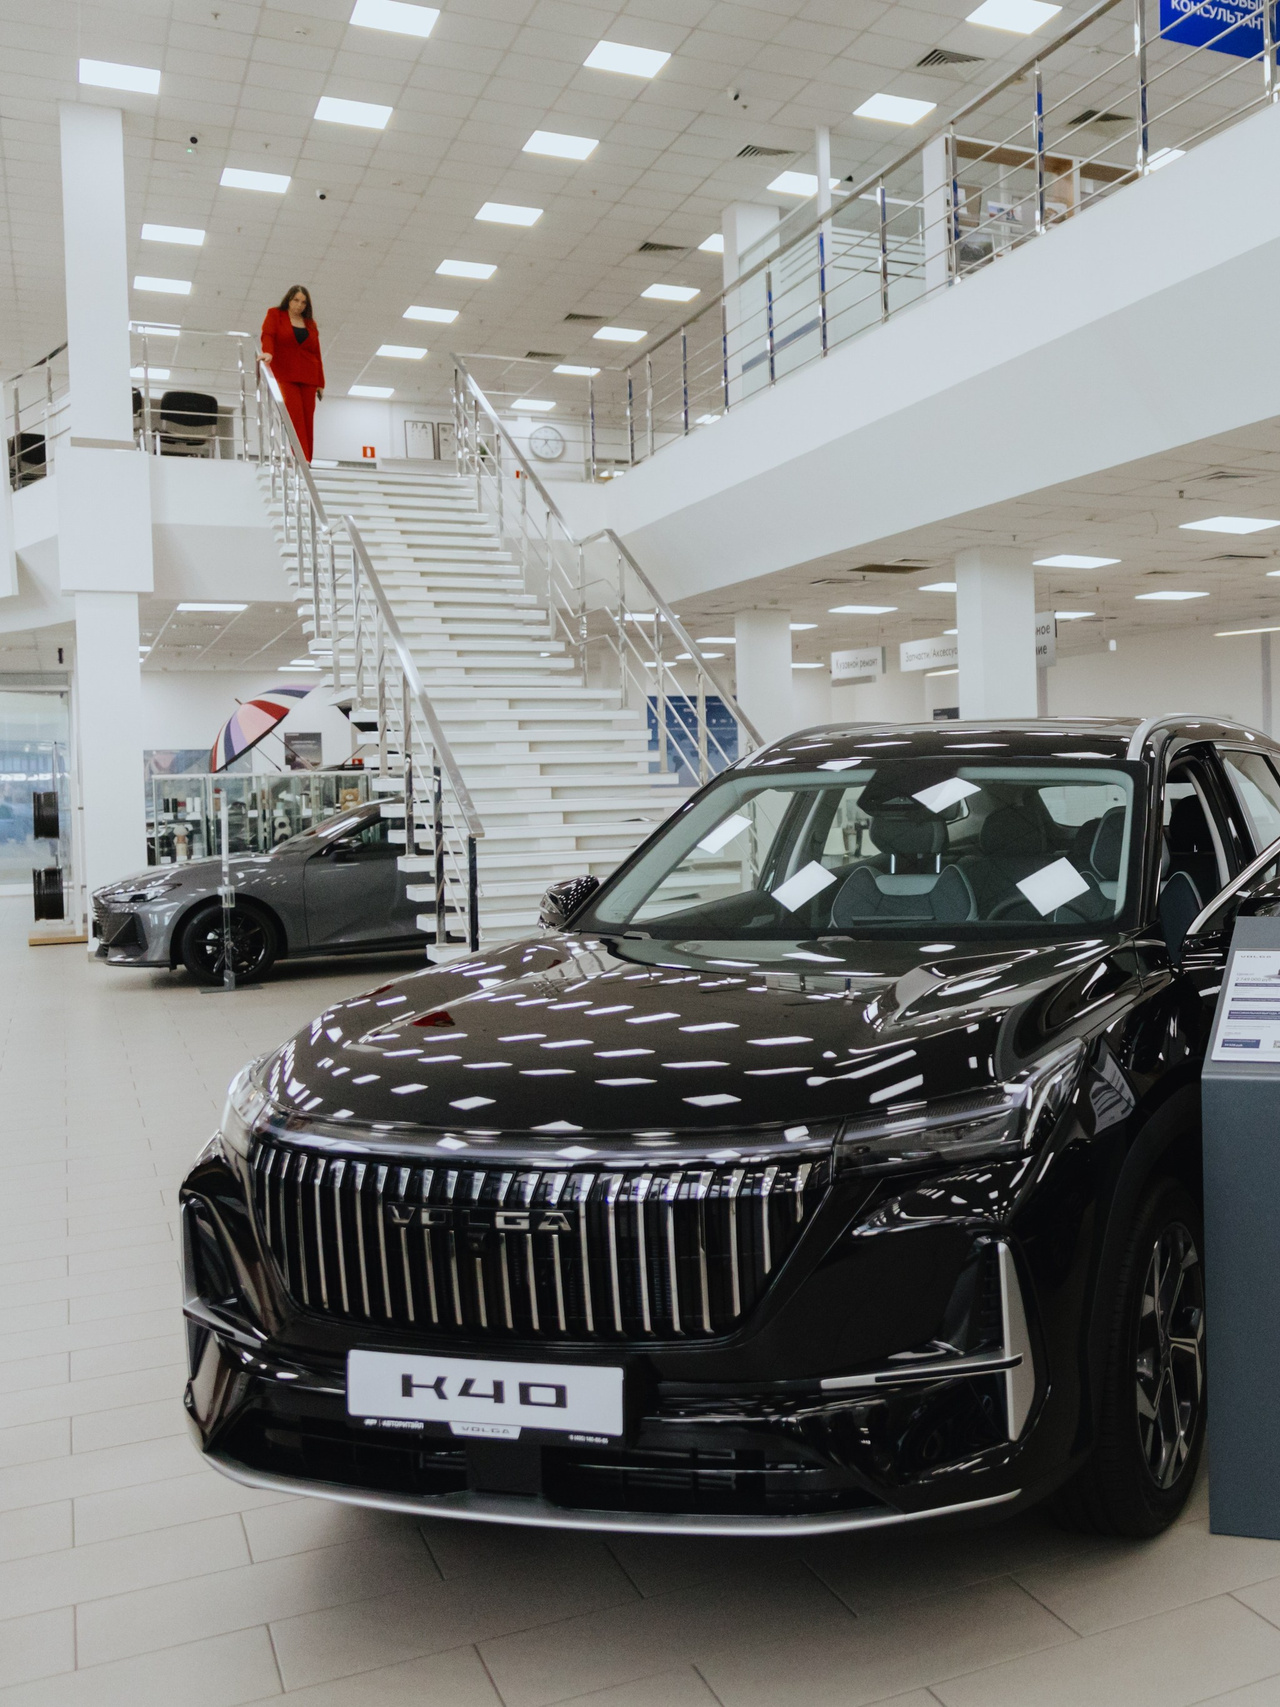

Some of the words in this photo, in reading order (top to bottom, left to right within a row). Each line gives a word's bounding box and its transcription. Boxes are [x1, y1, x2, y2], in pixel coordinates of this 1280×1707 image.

[1171, 0, 1264, 30] КОНСУЛЬТАН
[1035, 624, 1051, 636] ное
[836, 656, 859, 672] Кузовной
[859, 658, 878, 671] ремонт
[387, 1205, 572, 1231] VOLGA
[401, 1373, 568, 1409] K40
[461, 1425, 511, 1434] VOLGA
